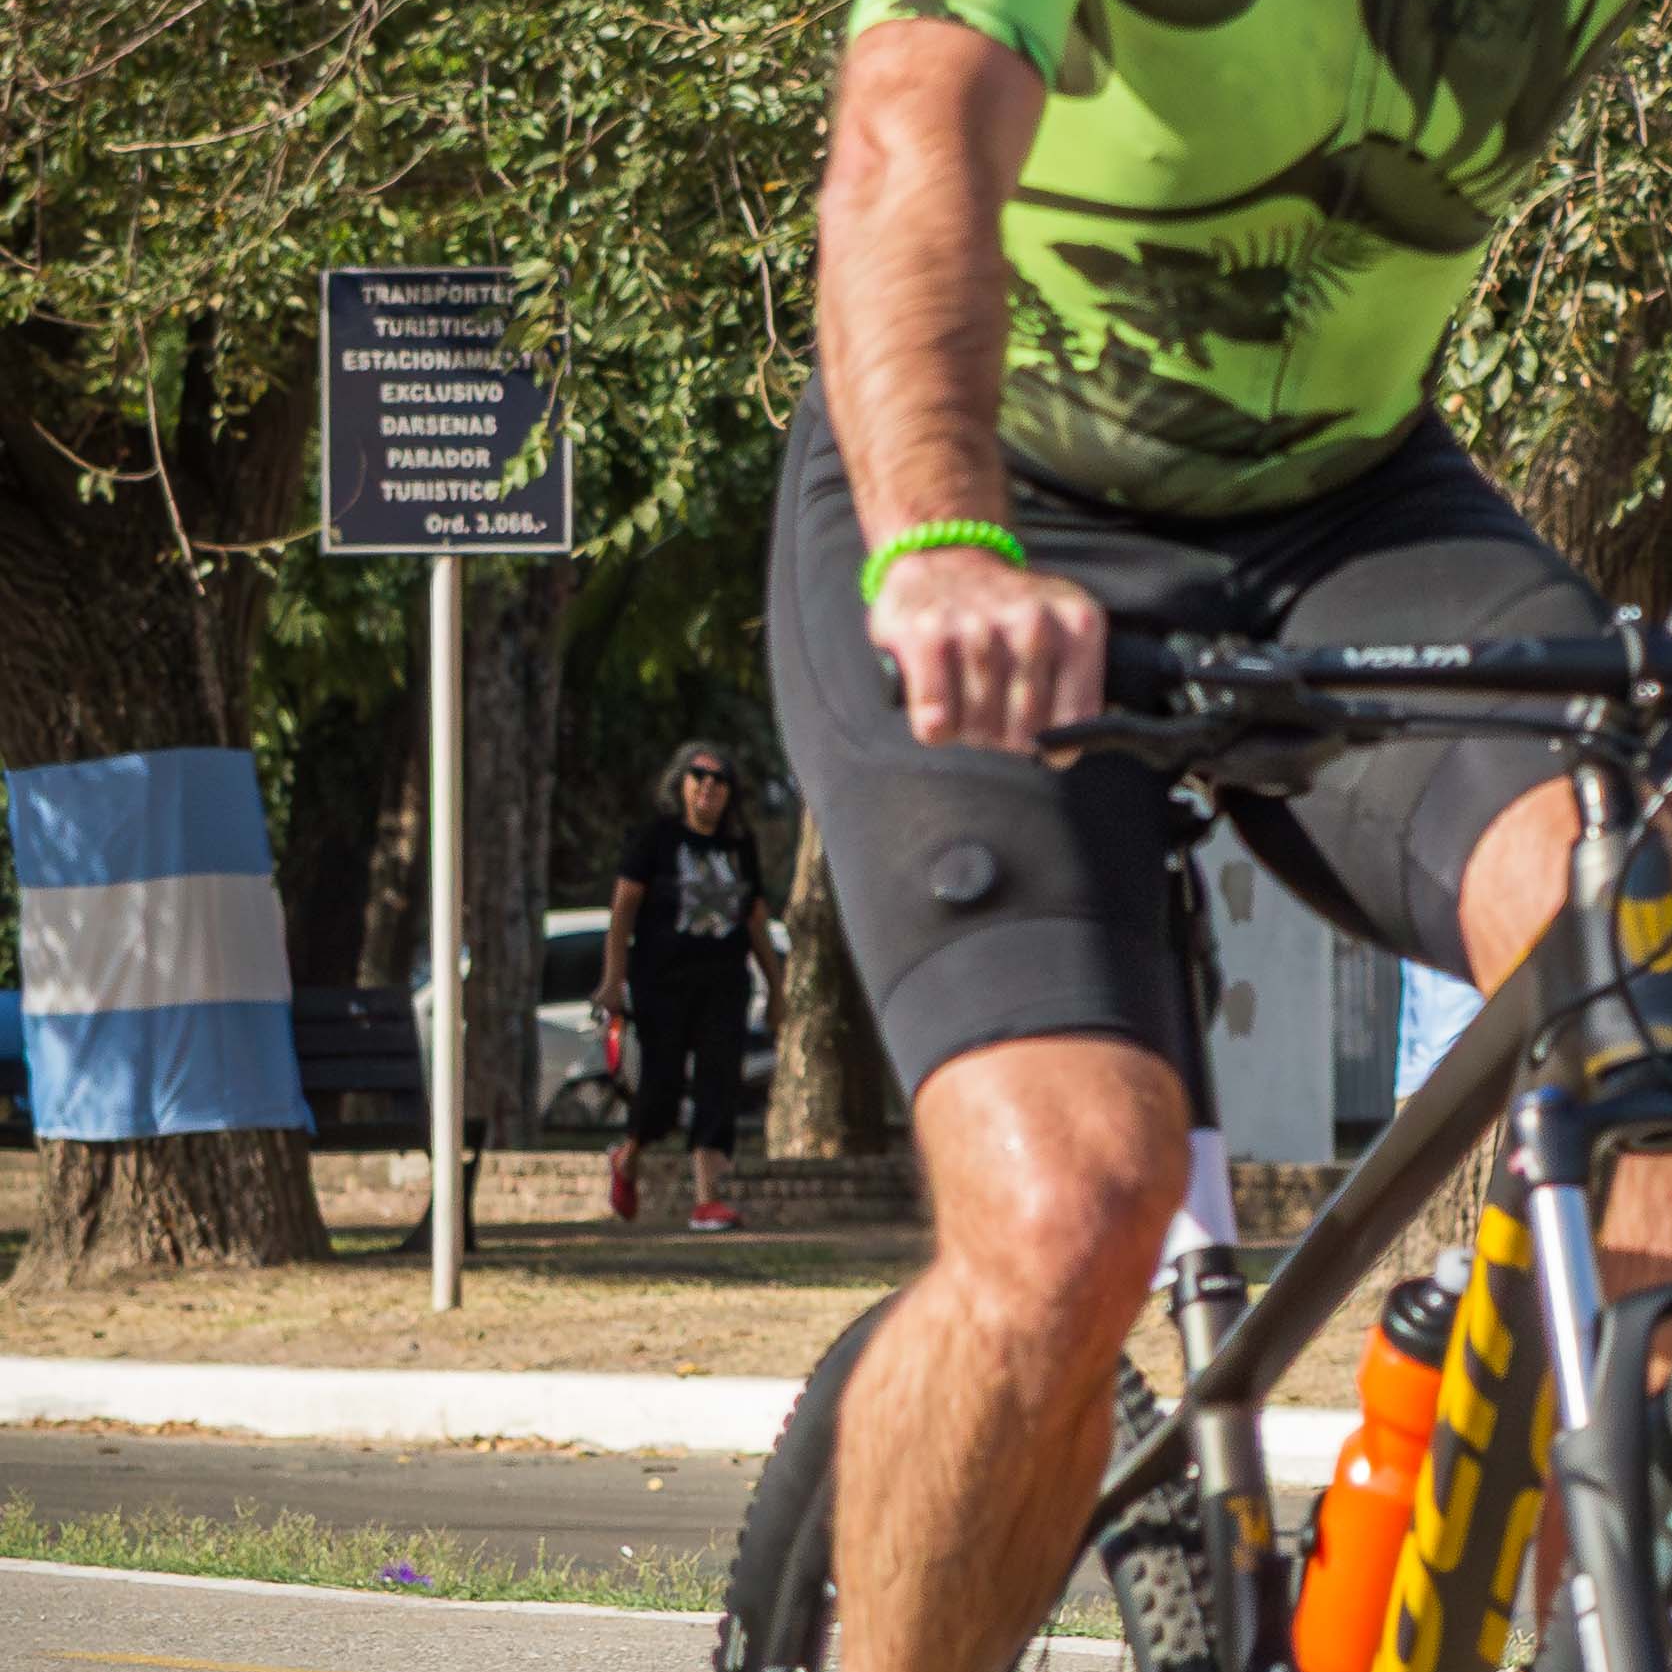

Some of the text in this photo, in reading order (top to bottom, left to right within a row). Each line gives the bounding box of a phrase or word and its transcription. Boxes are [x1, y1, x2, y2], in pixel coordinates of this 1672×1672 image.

[380, 382, 504, 403] EXCLUSIVO
[381, 414, 497, 436] DARSENAS
[387, 447, 491, 469] PARADOR
[381, 479, 500, 502] TURISTICO
[425, 512, 470, 534] Ord.
